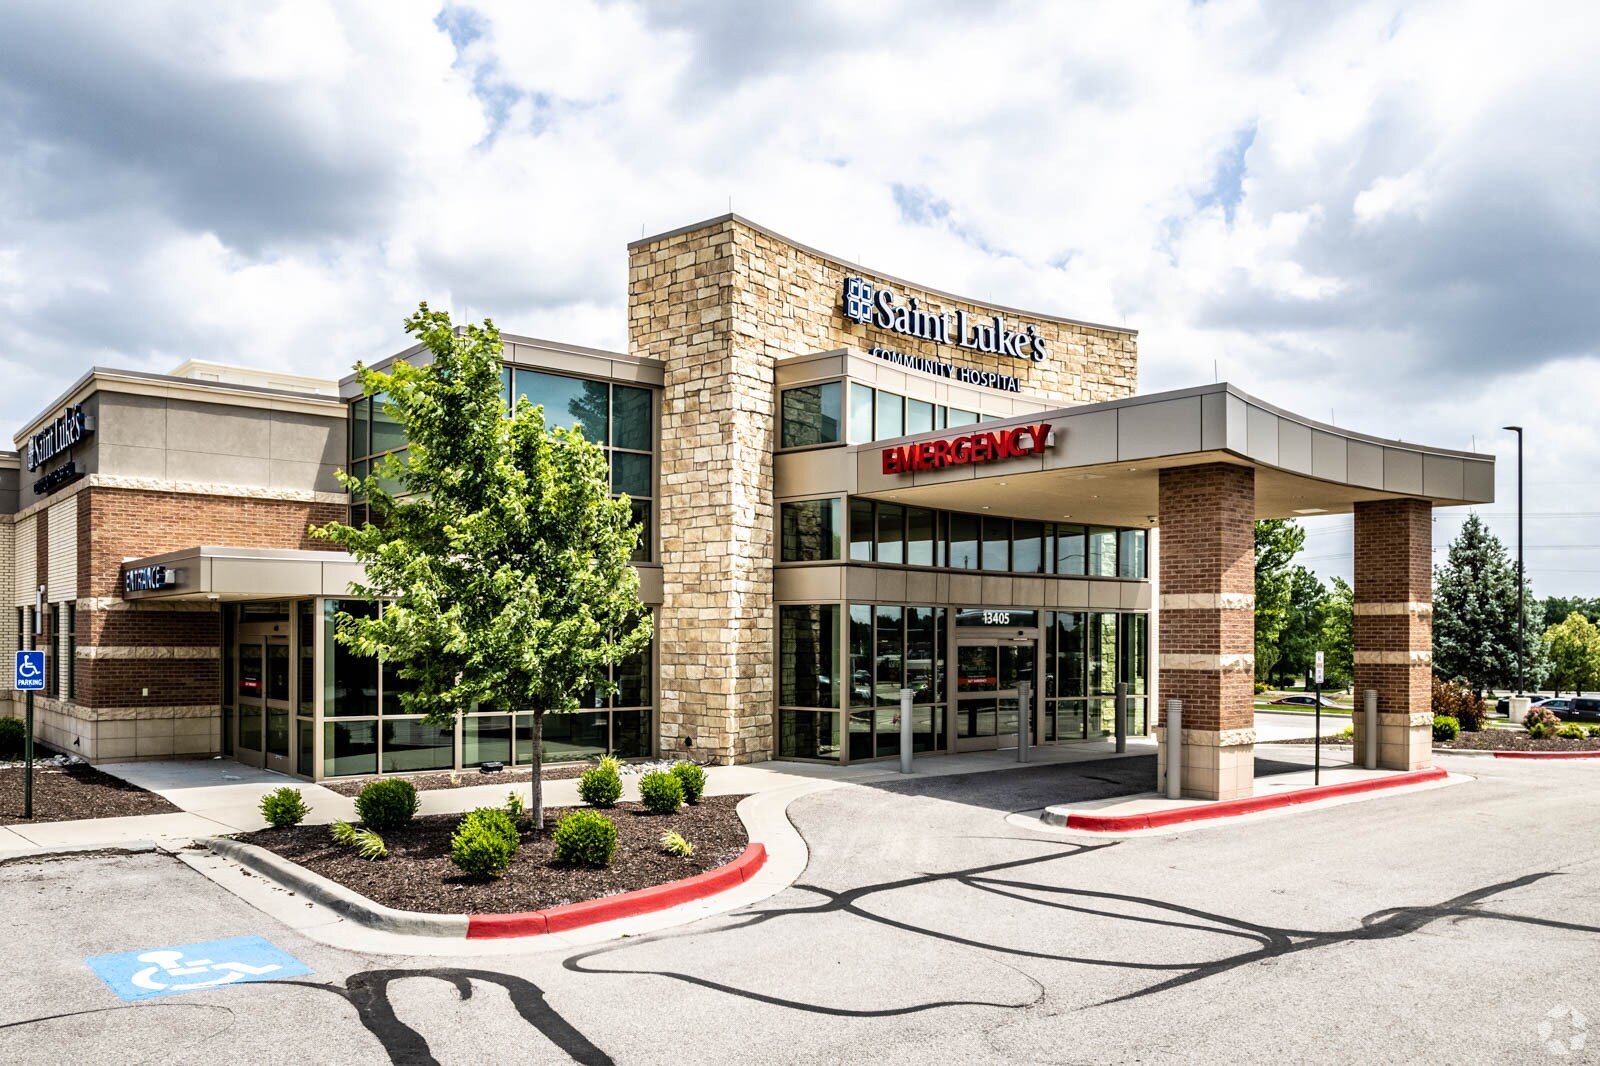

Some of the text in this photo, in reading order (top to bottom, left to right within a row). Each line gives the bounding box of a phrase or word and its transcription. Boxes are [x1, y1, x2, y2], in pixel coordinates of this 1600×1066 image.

[875, 289, 1048, 362] Saint Luke's
[872, 347, 1023, 393] COMMUNITY HOSPITAL
[34, 404, 81, 467] Saint Luke's
[882, 424, 1051, 475] EMERGENCY
[126, 566, 160, 592] ENTRANCE
[983, 612, 1010, 625] 13405
